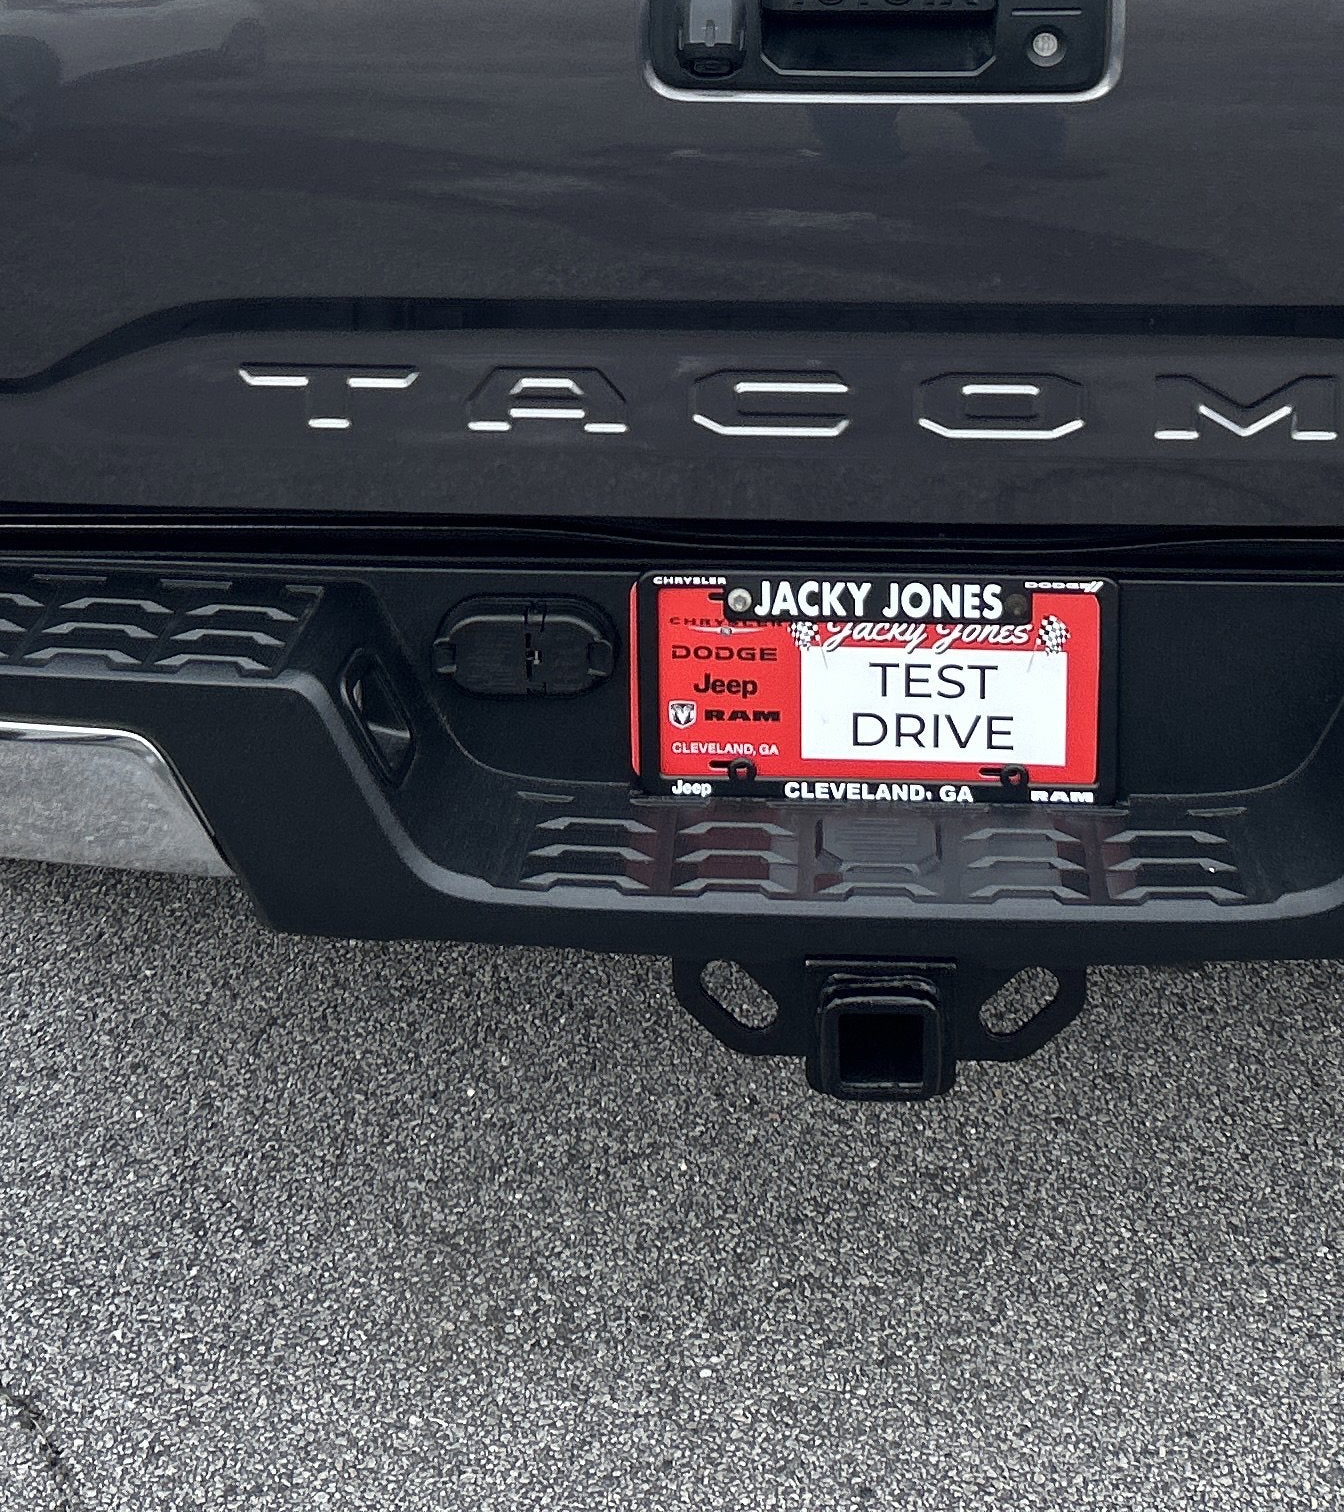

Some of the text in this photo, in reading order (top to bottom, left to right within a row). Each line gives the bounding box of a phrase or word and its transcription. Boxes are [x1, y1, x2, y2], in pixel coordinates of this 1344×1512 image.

[653, 576, 727, 585] CHRYSLER
[754, 580, 1003, 619] JACKY JONES
[823, 622, 1033, 654] Jacky Jones
[671, 644, 778, 662] DODGE
[693, 673, 758, 699] Jeep
[869, 662, 998, 699] TEST
[704, 708, 781, 722] RAM
[852, 712, 1014, 750] DRIVE
[671, 742, 779, 756] CLEVELAND, GA
[671, 779, 712, 798] Jeep
[784, 782, 974, 803] CLEVELAND, GA
[1030, 790, 1094, 803] RAM
